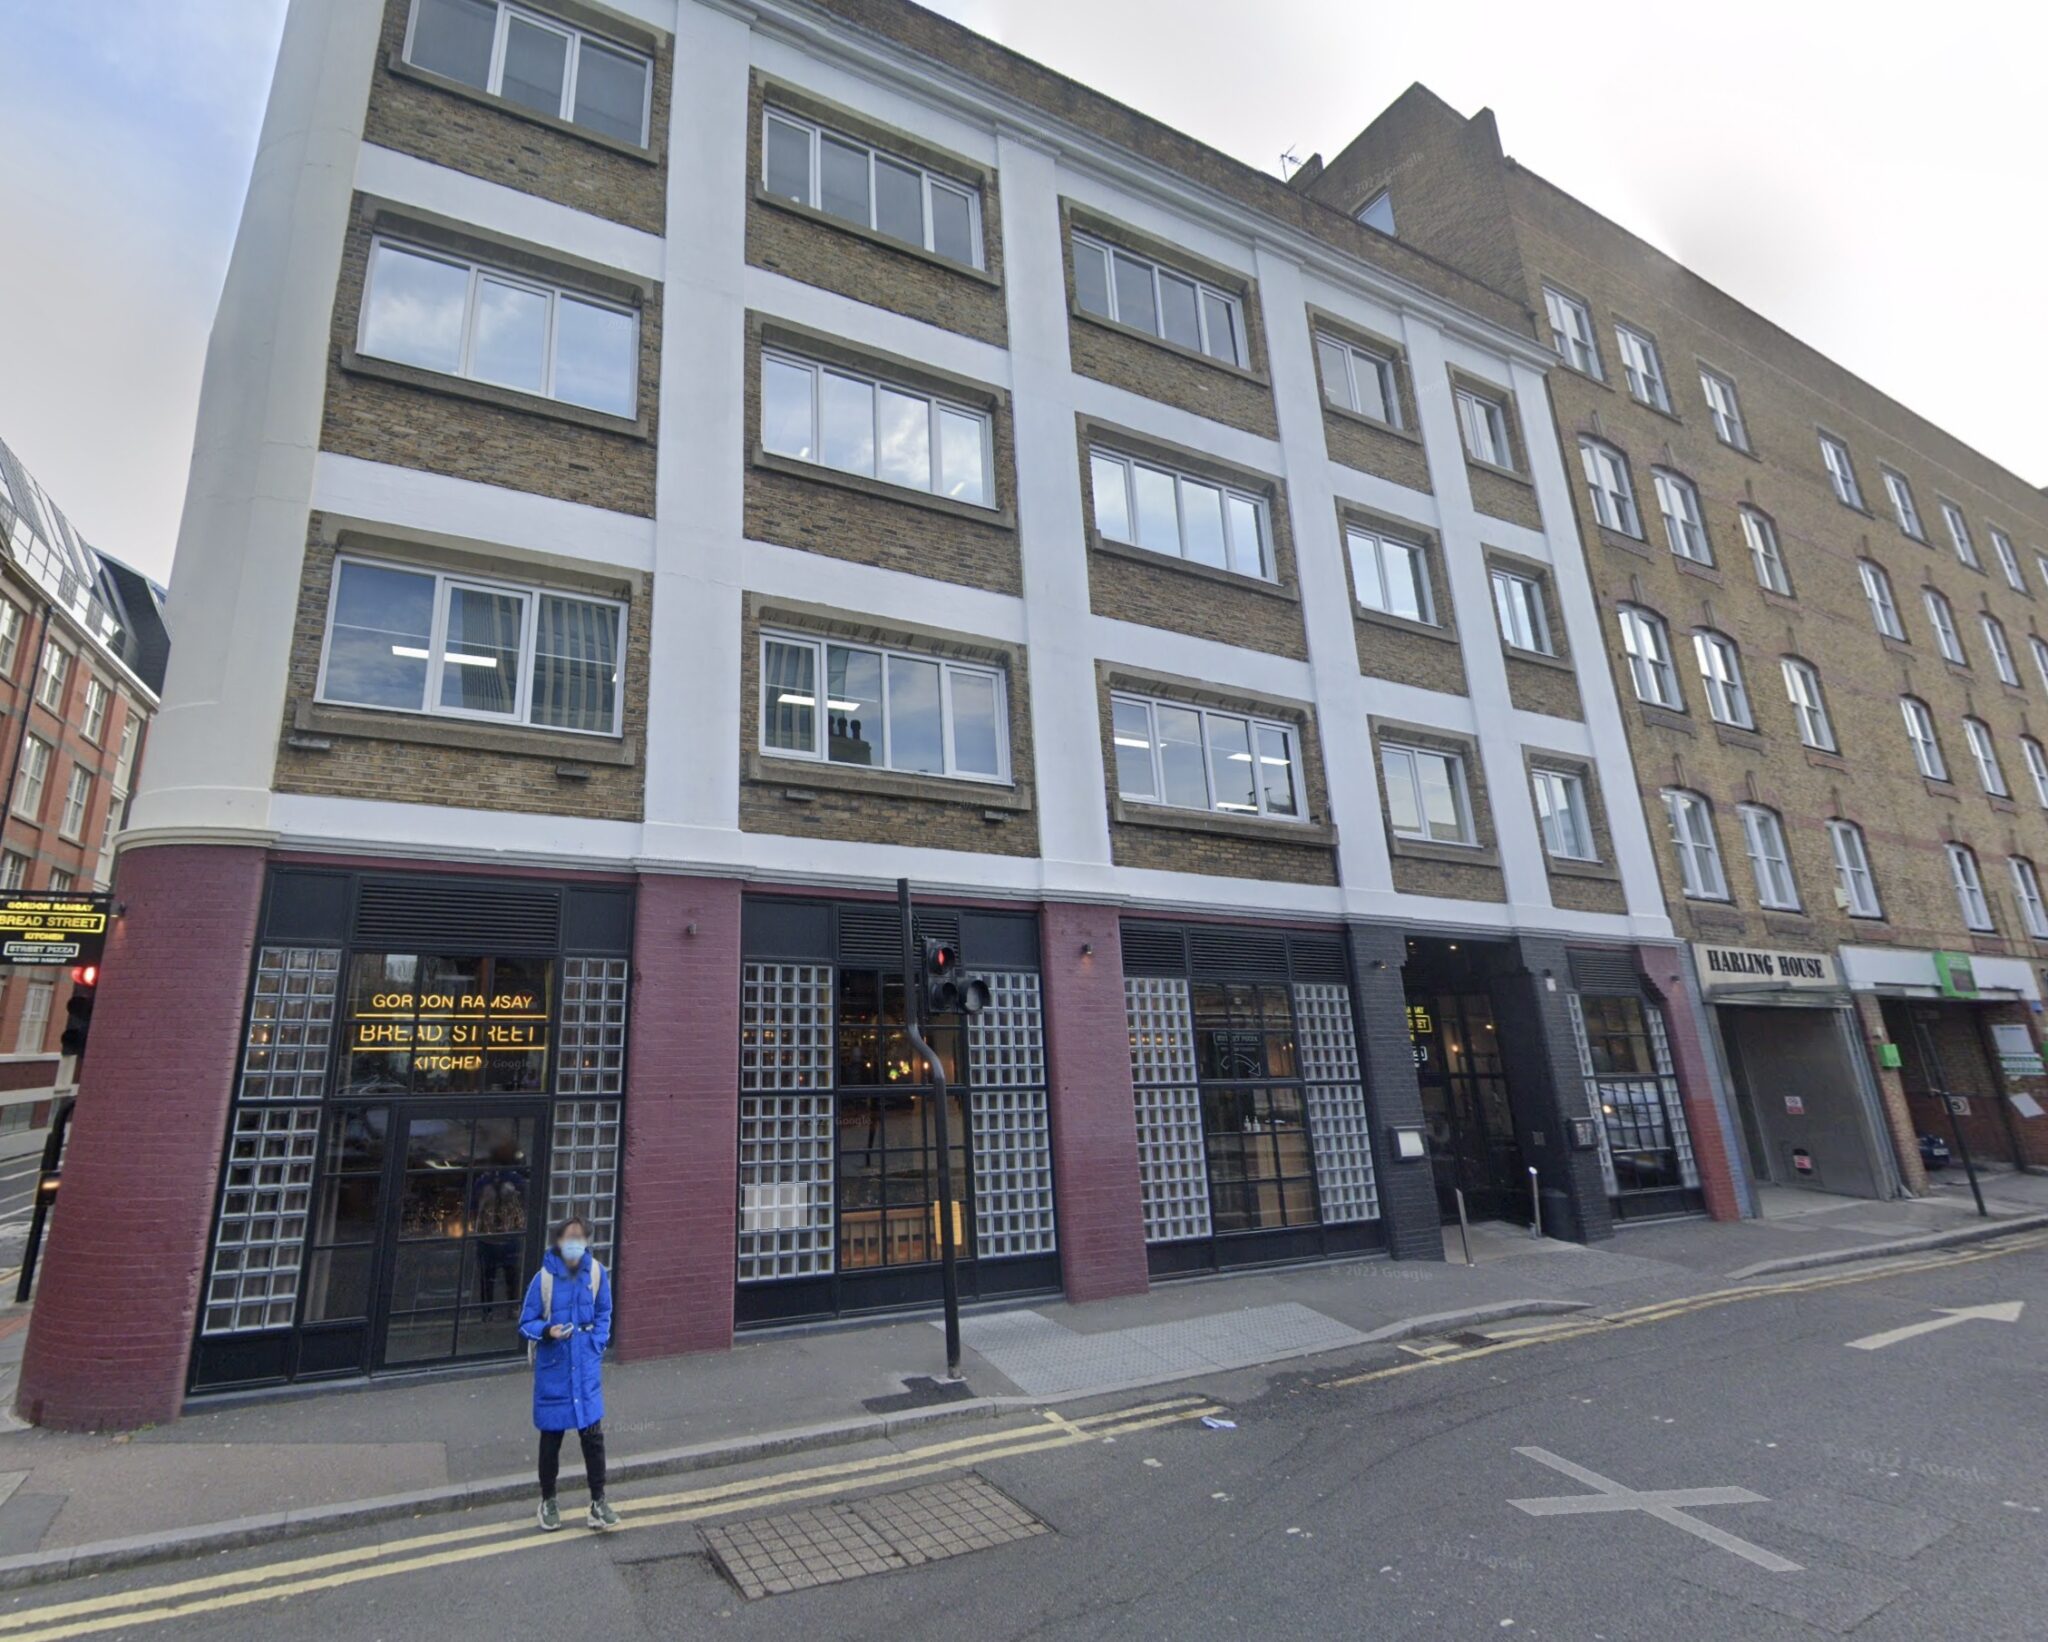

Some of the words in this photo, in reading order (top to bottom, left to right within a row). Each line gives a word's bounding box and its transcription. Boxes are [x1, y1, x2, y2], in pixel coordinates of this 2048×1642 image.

[7, 901, 50, 910] GORDON
[53, 903, 94, 912] RAMSAY
[0, 915, 42, 926] BREAD
[47, 917, 98, 928] STREET
[24, 932, 65, 941] KITCHEN
[8, 945, 45, 953] STREET
[46, 946, 74, 954] PIZZA
[1707, 949, 1774, 976] HARLING
[1777, 956, 1825, 979] HOUSE
